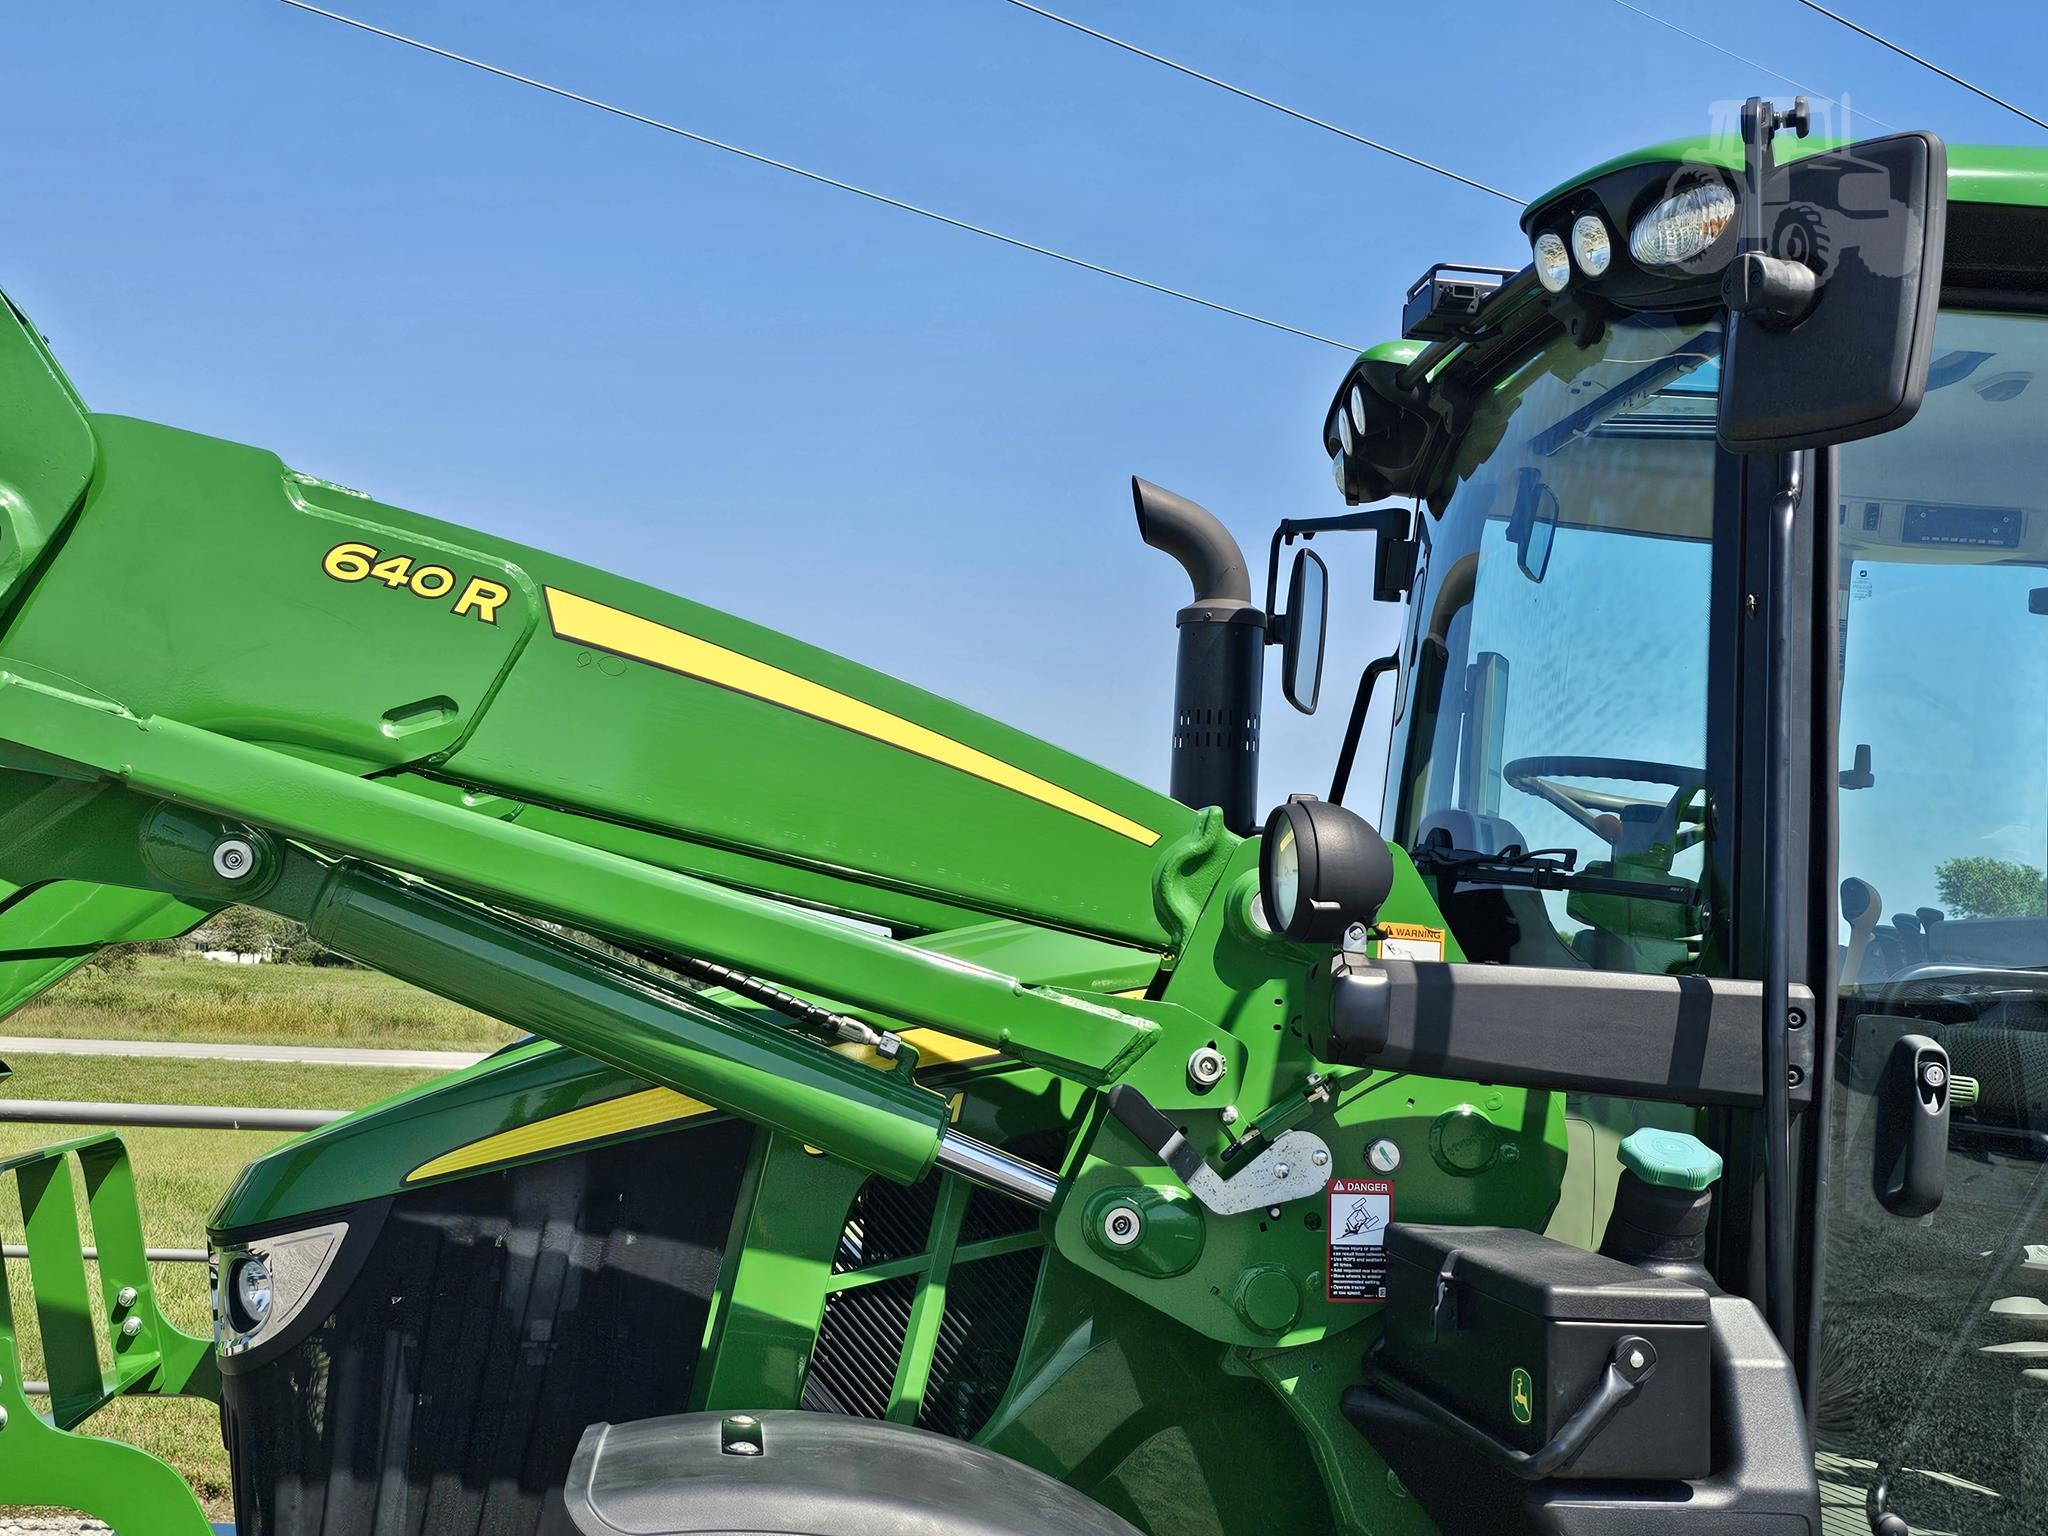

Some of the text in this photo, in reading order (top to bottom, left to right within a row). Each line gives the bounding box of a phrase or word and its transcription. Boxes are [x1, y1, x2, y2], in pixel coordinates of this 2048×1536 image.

[322, 541, 511, 625] 640 R
[1396, 928, 1441, 939] WARNING
[1347, 1182, 1388, 1192] DANGER
